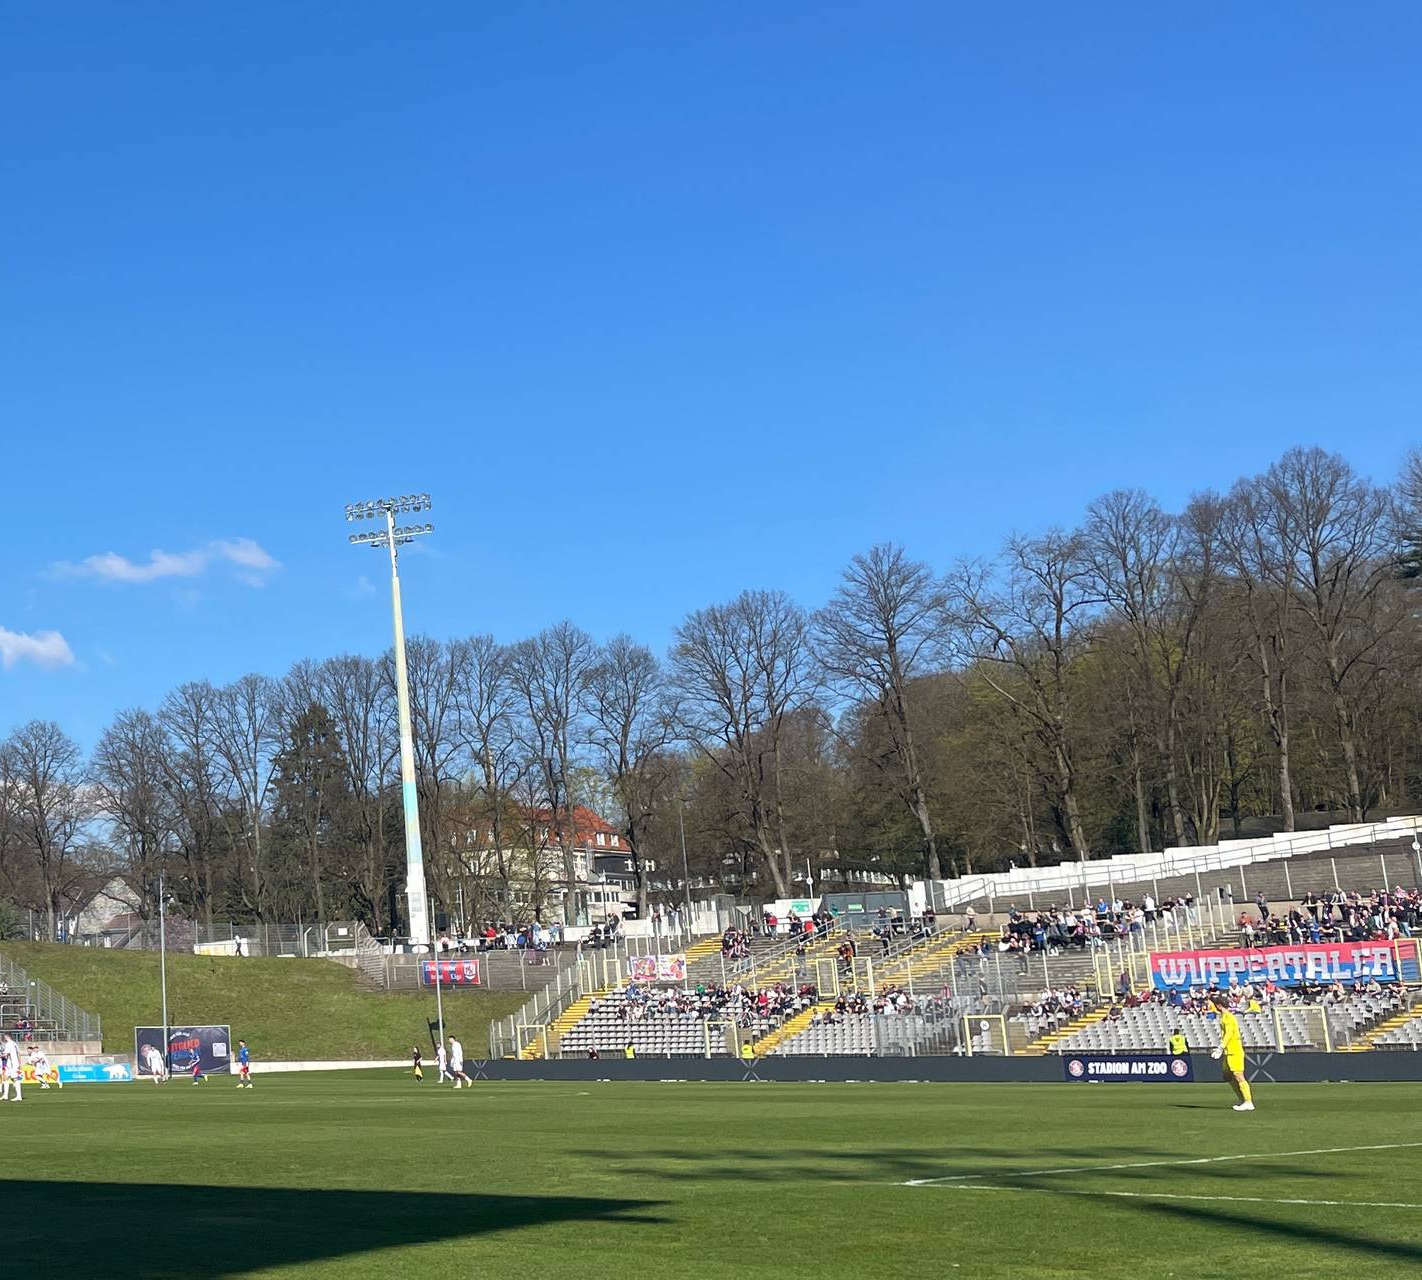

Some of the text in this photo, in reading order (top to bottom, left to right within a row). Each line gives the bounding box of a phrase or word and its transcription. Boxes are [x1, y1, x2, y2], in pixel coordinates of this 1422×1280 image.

[1088, 1062, 1168, 1075] STADION AM ZOO
